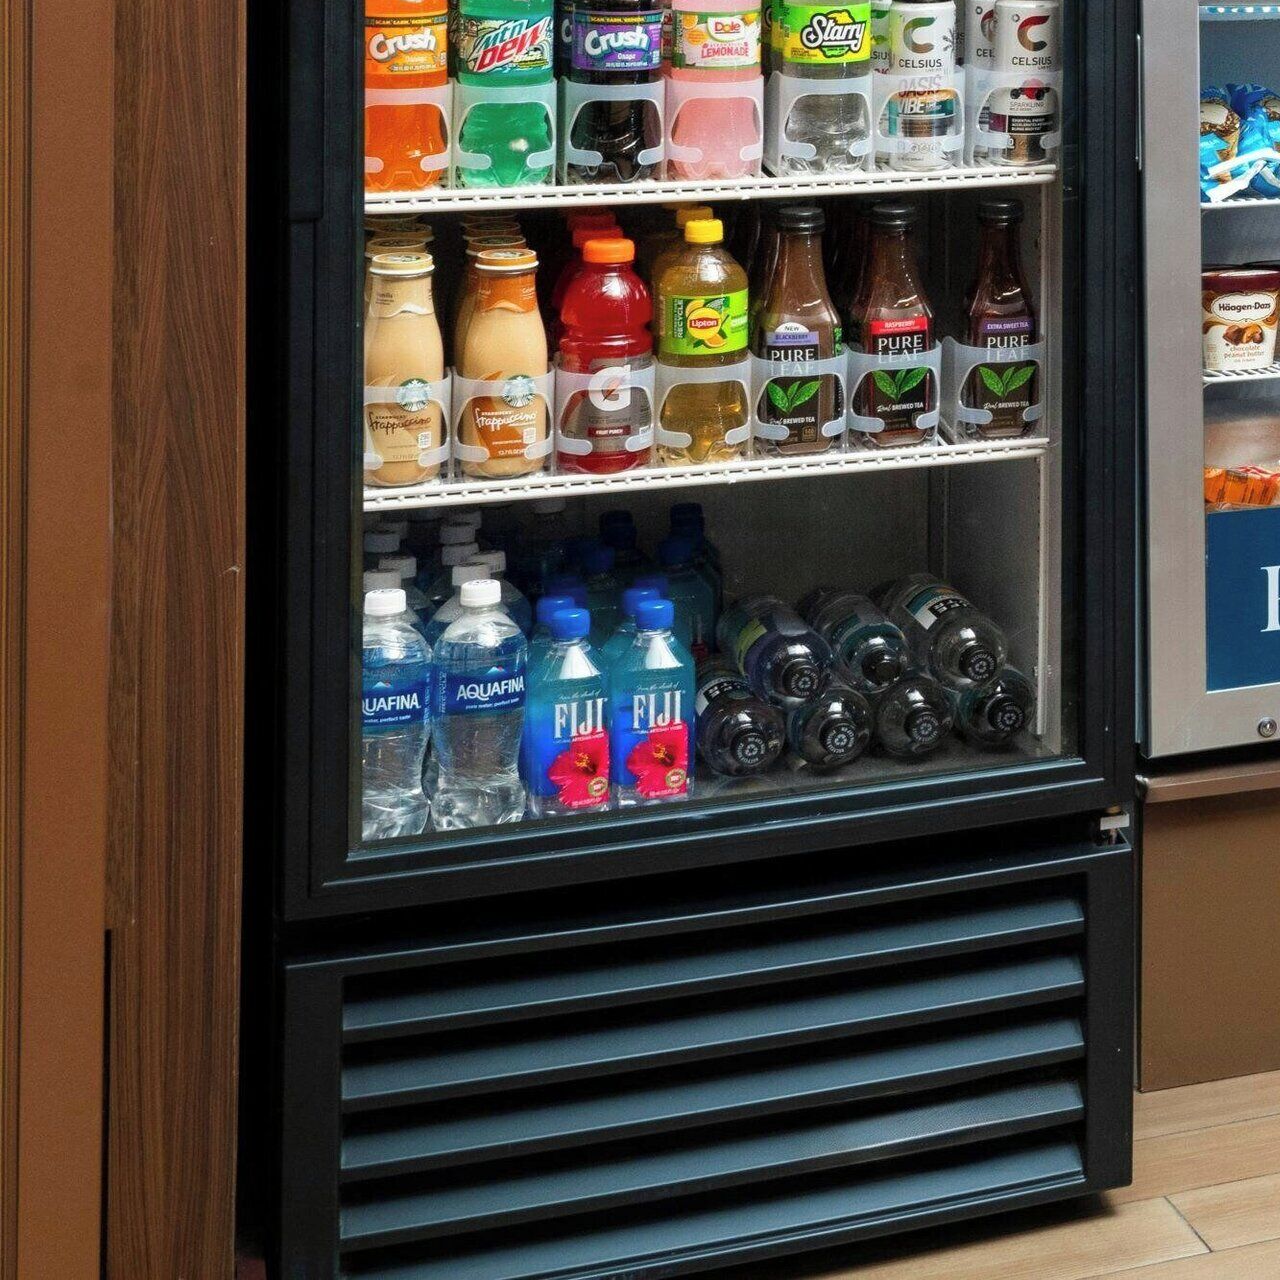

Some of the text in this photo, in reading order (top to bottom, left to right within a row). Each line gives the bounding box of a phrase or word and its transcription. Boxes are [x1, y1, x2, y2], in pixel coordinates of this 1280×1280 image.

[714, 22, 741, 32] Dole
[802, 15, 867, 53] Starry
[369, 27, 436, 61] Crush
[585, 29, 649, 59] Crush
[702, 47, 749, 59] LEMONADE
[899, 59, 942, 69] CELSIUS
[1012, 56, 1052, 66] CELSIUS
[1219, 302, 1271, 313] Häagen-Dazs
[691, 318, 717, 328] Lipton
[884, 321, 916, 329] RASPBERRY
[877, 334, 923, 350] PURE
[987, 334, 1030, 349] PURE
[770, 349, 815, 363] PURE
[588, 364, 631, 411] G
[892, 402, 914, 410] BREWED
[997, 402, 1019, 410] BREWED
[783, 417, 805, 425] BREWED
[456, 676, 525, 703] AQUAFINA
[632, 690, 683, 731] FIJI
[554, 698, 605, 740] FIJI
